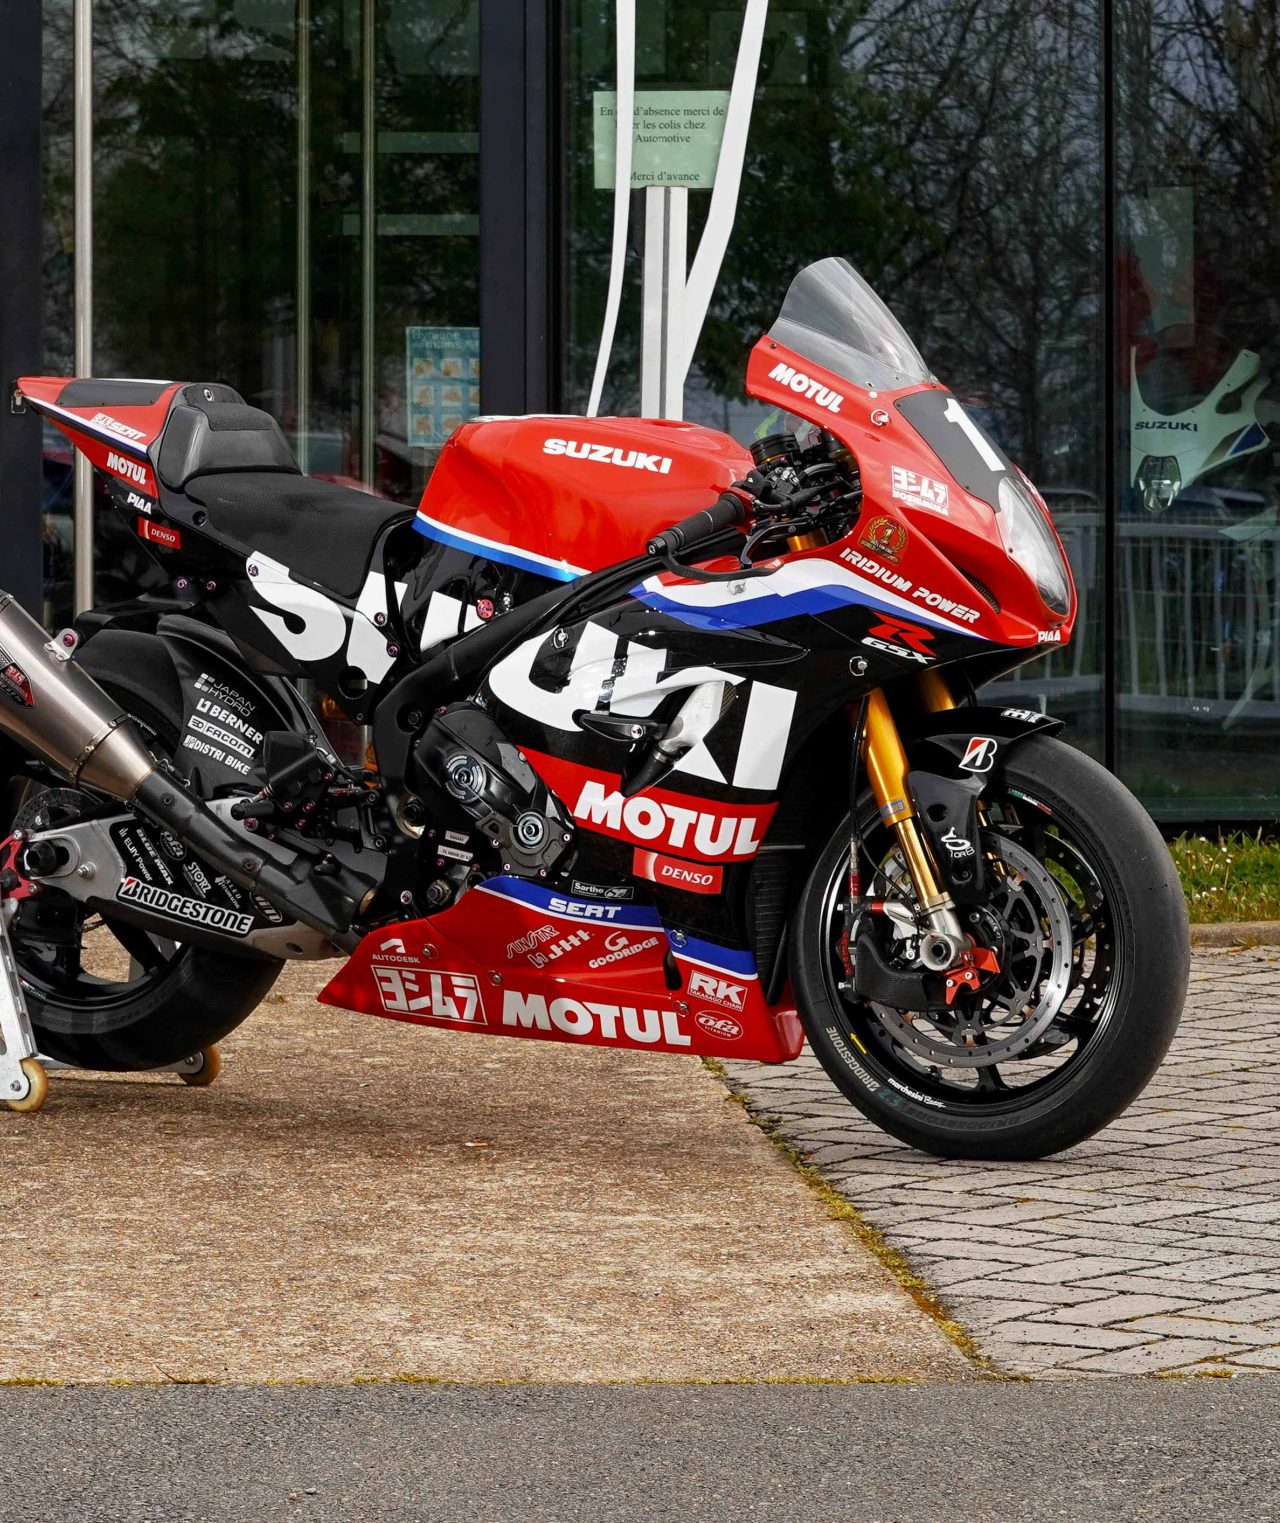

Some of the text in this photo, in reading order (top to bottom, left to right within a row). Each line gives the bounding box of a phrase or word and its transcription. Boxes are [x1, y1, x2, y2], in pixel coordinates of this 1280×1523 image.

[600, 106, 724, 116] En d'absence merci de
[643, 120, 656, 129] les
[659, 120, 680, 129] colis
[684, 120, 706, 129] chez
[635, 134, 691, 143] Automotive
[657, 172, 700, 181] d'avance
[769, 363, 844, 414] MOTUL
[944, 398, 1006, 471] 1
[1134, 421, 1199, 432] SUZUKI
[106, 452, 146, 485] MOTUL
[543, 438, 672, 474] SUZUKI
[127, 492, 152, 514] PIAA
[151, 528, 176, 543] DENSO
[839, 547, 981, 624] IRIDIUM POWER
[861, 637, 937, 665] GSX
[1037, 630, 1061, 643] PIAA
[208, 687, 251, 717] HYDRO
[213, 683, 256, 711] JAPAN
[209, 705, 263, 744] BERNER
[193, 740, 251, 775] DISTRI BIKE
[573, 780, 760, 856] MOTUL
[136, 857, 152, 881] Power
[188, 862, 211, 893] STORZ
[662, 865, 713, 885] DENSO
[118, 877, 254, 935] BRIDGESTONE
[548, 897, 622, 919] SERT
[372, 953, 420, 963] AUTODESK
[588, 937, 659, 969] GOODRIDGE
[375, 968, 480, 1020] ヨシムラ
[690, 972, 745, 1005] RK
[503, 990, 691, 1046] MOTUL
[722, 1000, 743, 1010] CHAIN
[825, 1026, 881, 1092] BRIDGESTONE
[887, 1077, 924, 1101] marchesini
